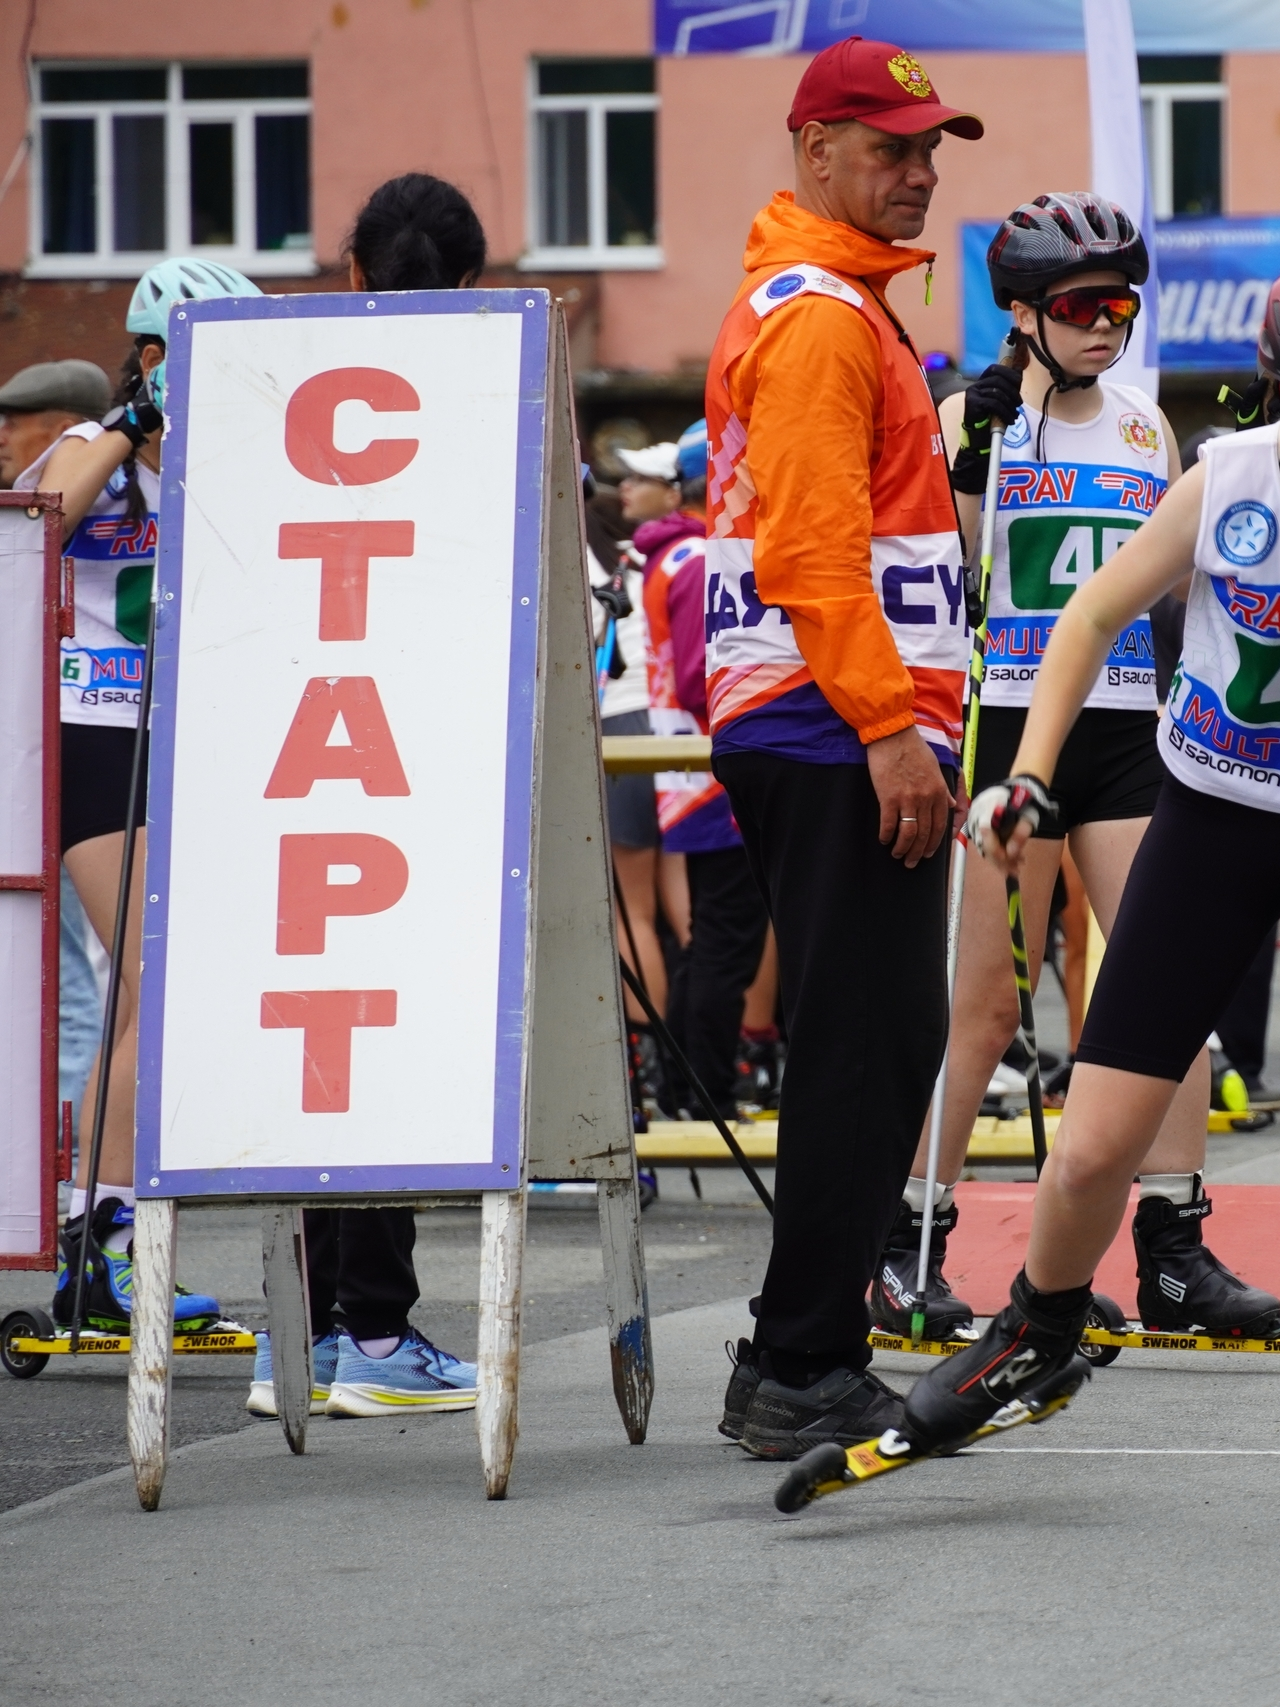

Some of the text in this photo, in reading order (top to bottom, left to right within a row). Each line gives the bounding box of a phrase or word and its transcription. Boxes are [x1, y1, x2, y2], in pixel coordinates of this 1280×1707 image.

[87, 518, 158, 557] RA
[260, 366, 421, 1114] СТАРТ
[1179, 1204, 1209, 1218] SPINE
[911, 1218, 952, 1227] SINE
[882, 1265, 917, 1308] SPINE
[183, 1336, 236, 1348] SWENOR
[871, 1337, 903, 1350] SWENOR
[1141, 1337, 1197, 1350] SWENOR
[753, 1400, 796, 1418] SALOMON
